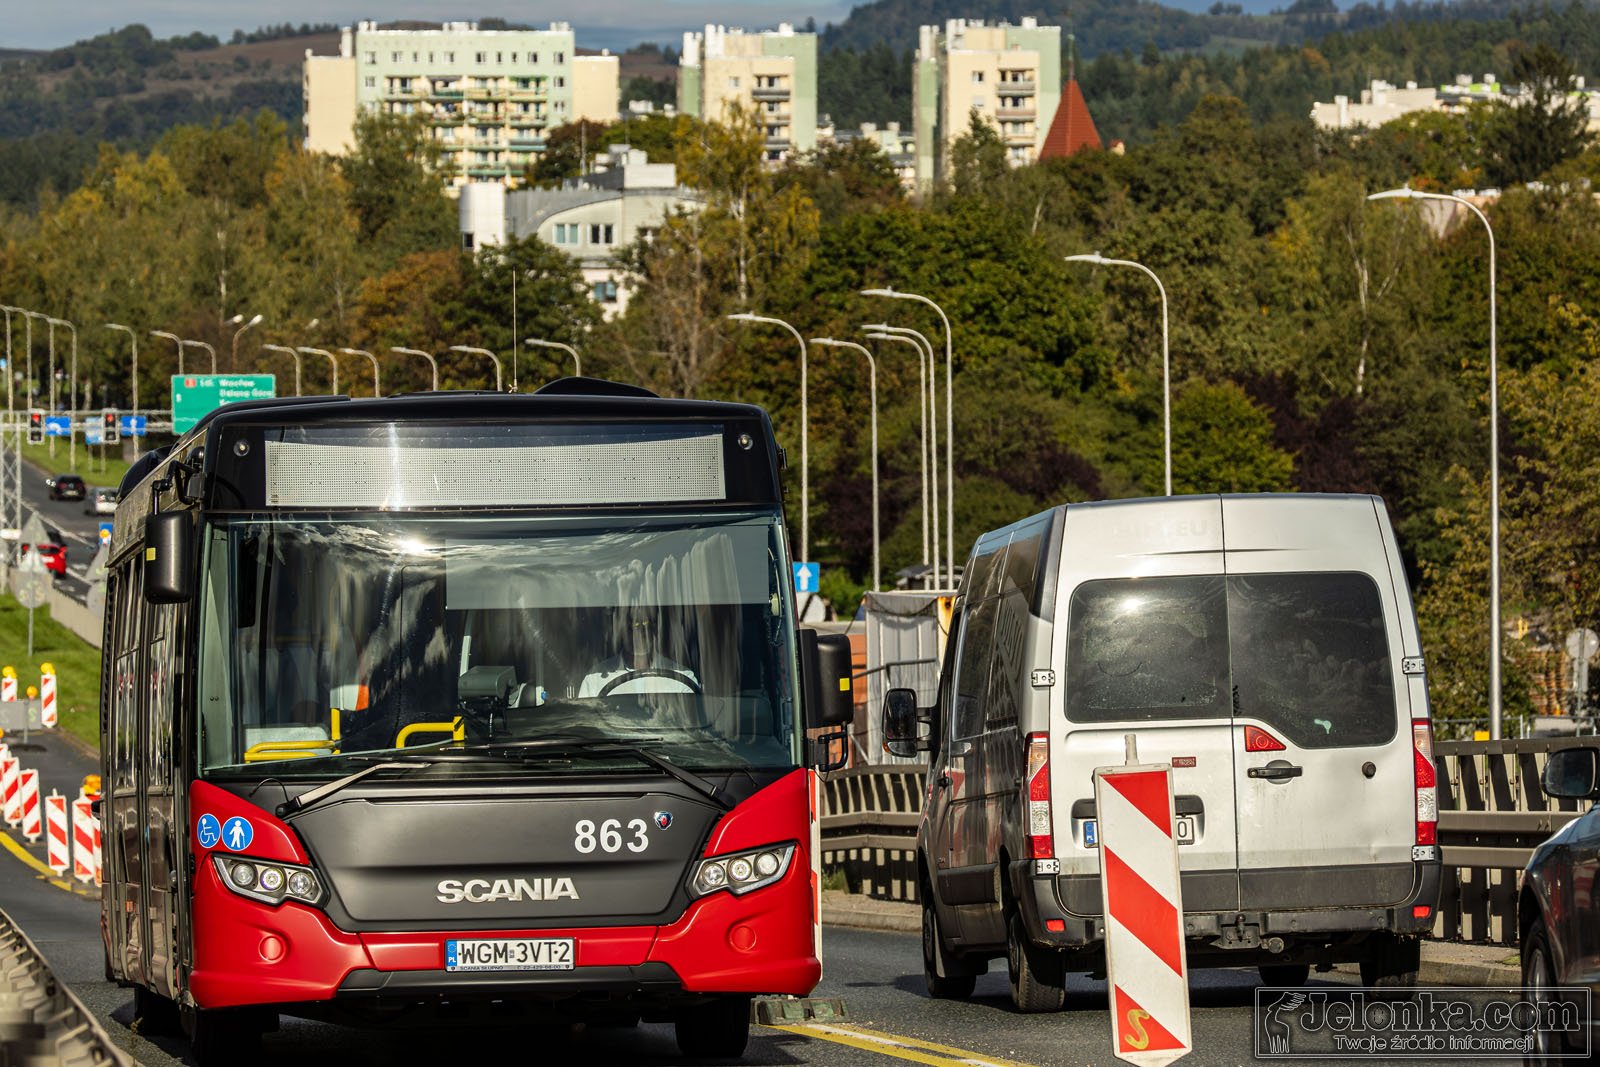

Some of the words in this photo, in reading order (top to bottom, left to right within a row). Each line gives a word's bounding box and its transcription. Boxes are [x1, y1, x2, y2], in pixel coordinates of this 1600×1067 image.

[574, 819, 649, 853] 863
[436, 877, 581, 904] SCANIA
[461, 942, 509, 964] WGM
[516, 941, 570, 963] 3VT2
[1124, 1008, 1150, 1050] S
